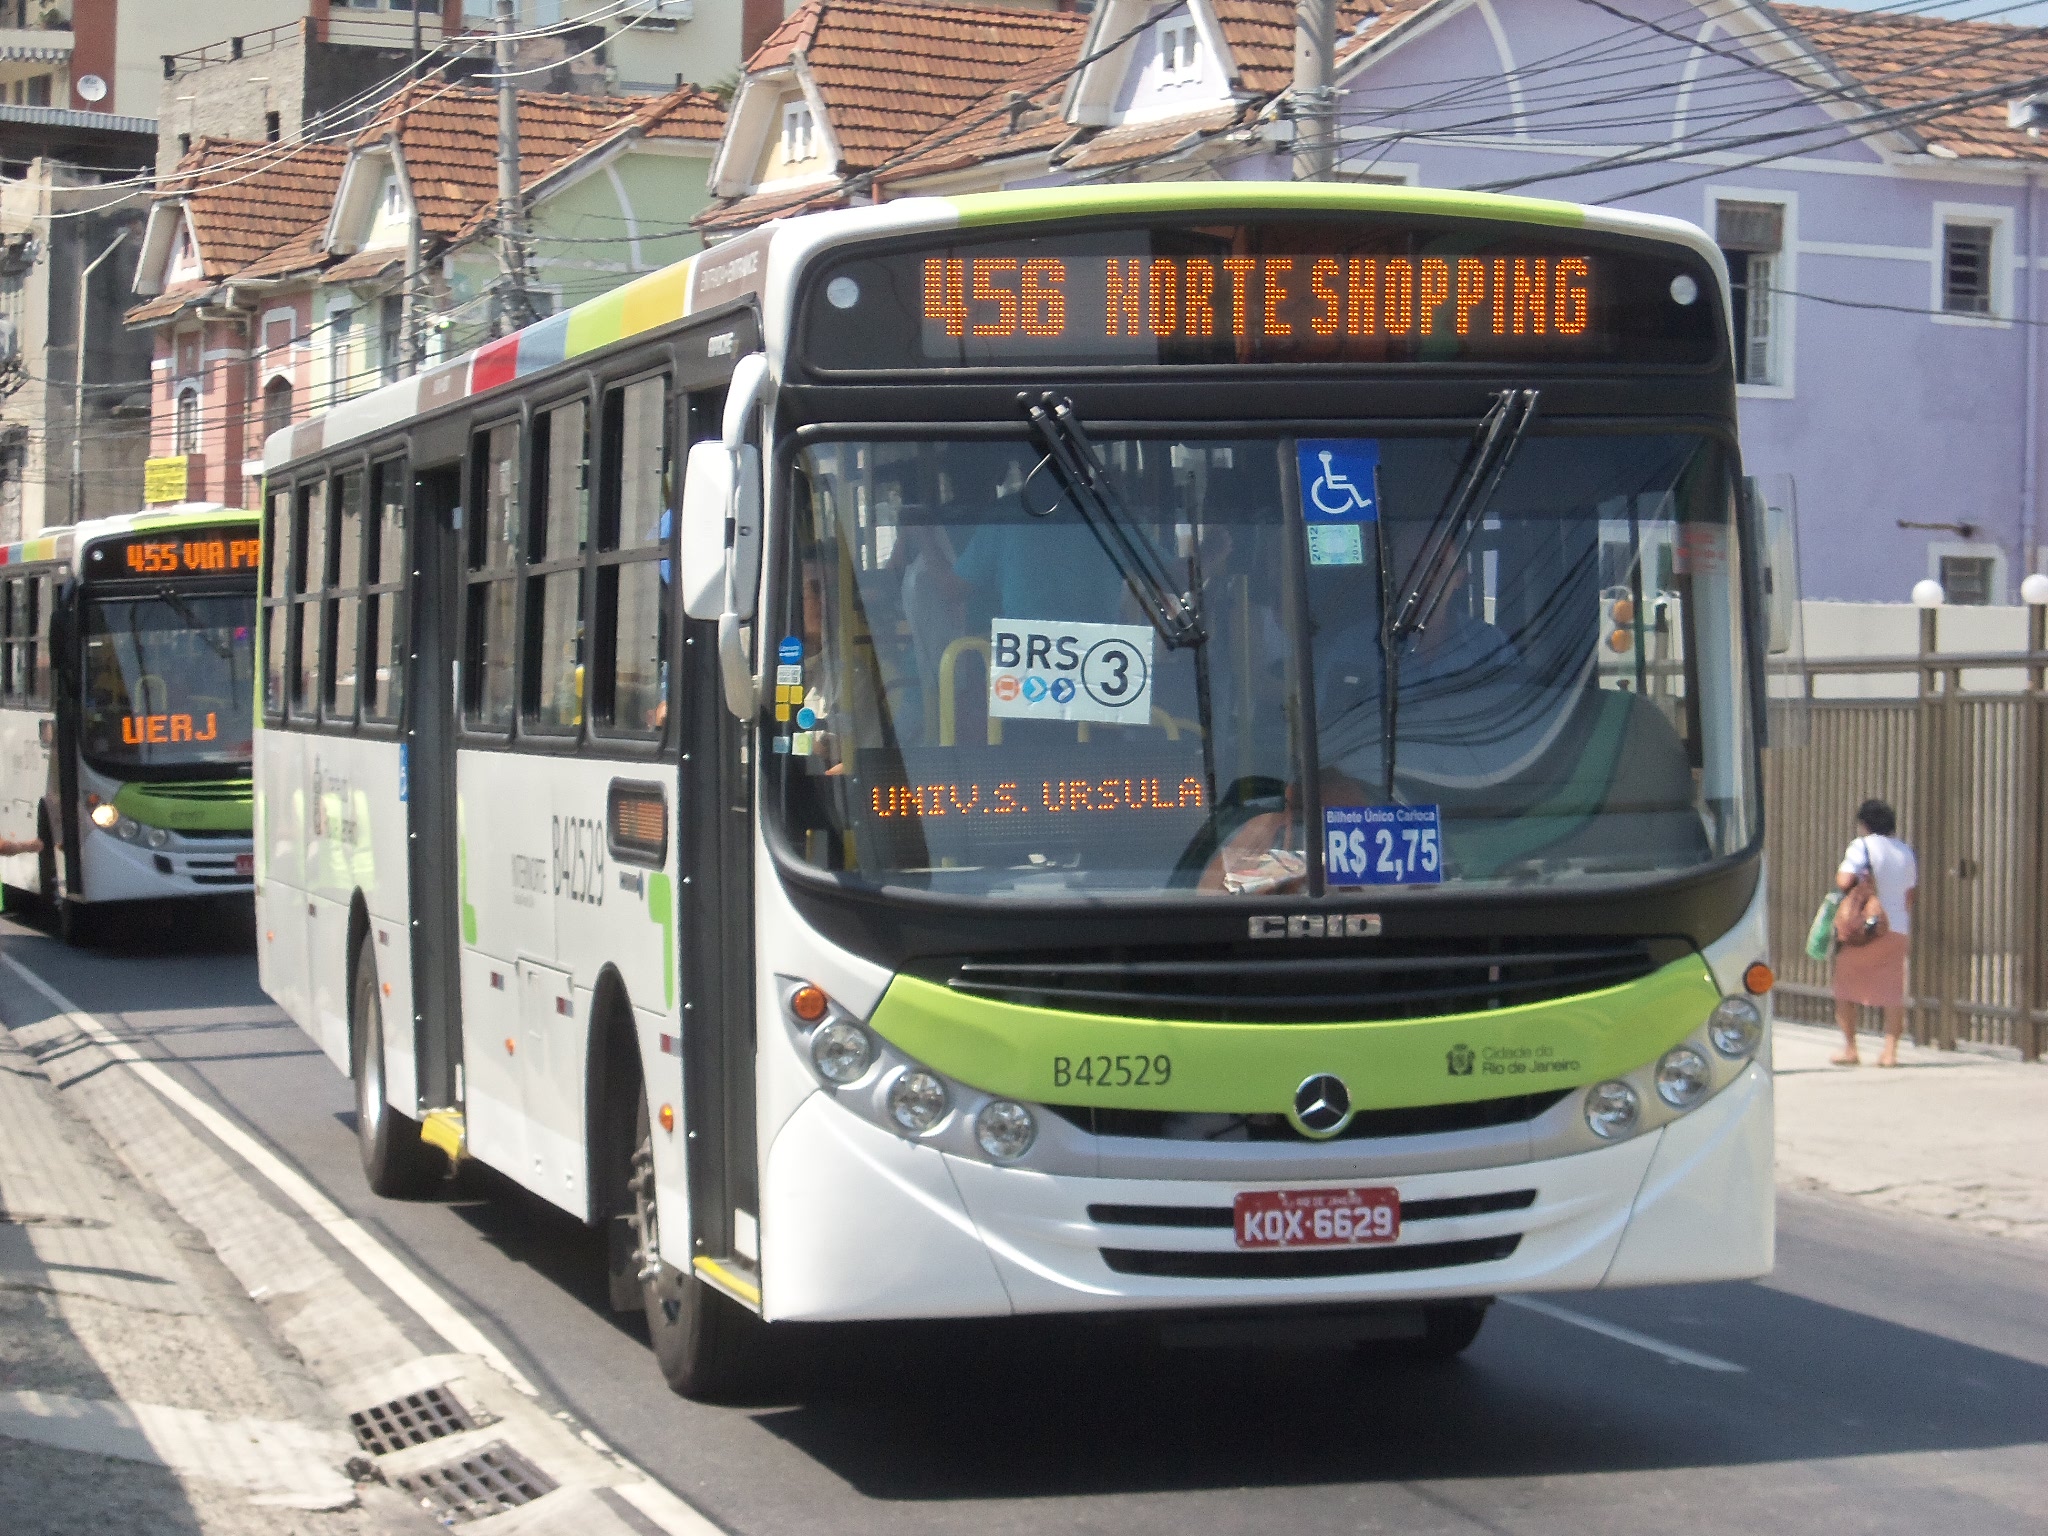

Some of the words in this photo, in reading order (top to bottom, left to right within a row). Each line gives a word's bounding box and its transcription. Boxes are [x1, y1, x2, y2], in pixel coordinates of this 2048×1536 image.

[923, 257, 1067, 337] 456
[1105, 257, 1294, 336] NORTE
[1310, 257, 1589, 336] SHOPPING
[126, 543, 179, 573] 455
[183, 540, 226, 571] VIA
[1310, 526, 1321, 561] 2012
[995, 632, 1079, 672] BRS
[1100, 650, 1129, 697] 3
[121, 711, 218, 745] UERJ
[1042, 777, 1202, 812] URSULA
[1326, 810, 1362, 823] Bilhete
[1364, 807, 1395, 822] Único
[1397, 809, 1436, 822] Carioca
[552, 814, 605, 907] B42529
[1328, 827, 1368, 878] R$
[1375, 828, 1439, 882] 2,75
[1248, 912, 1383, 939] CAIO
[1053, 1053, 1172, 1087] B42529
[1482, 1061, 1504, 1075] Rio
[1507, 1060, 1526, 1074] de
[1530, 1058, 1581, 1073] Janeiro
